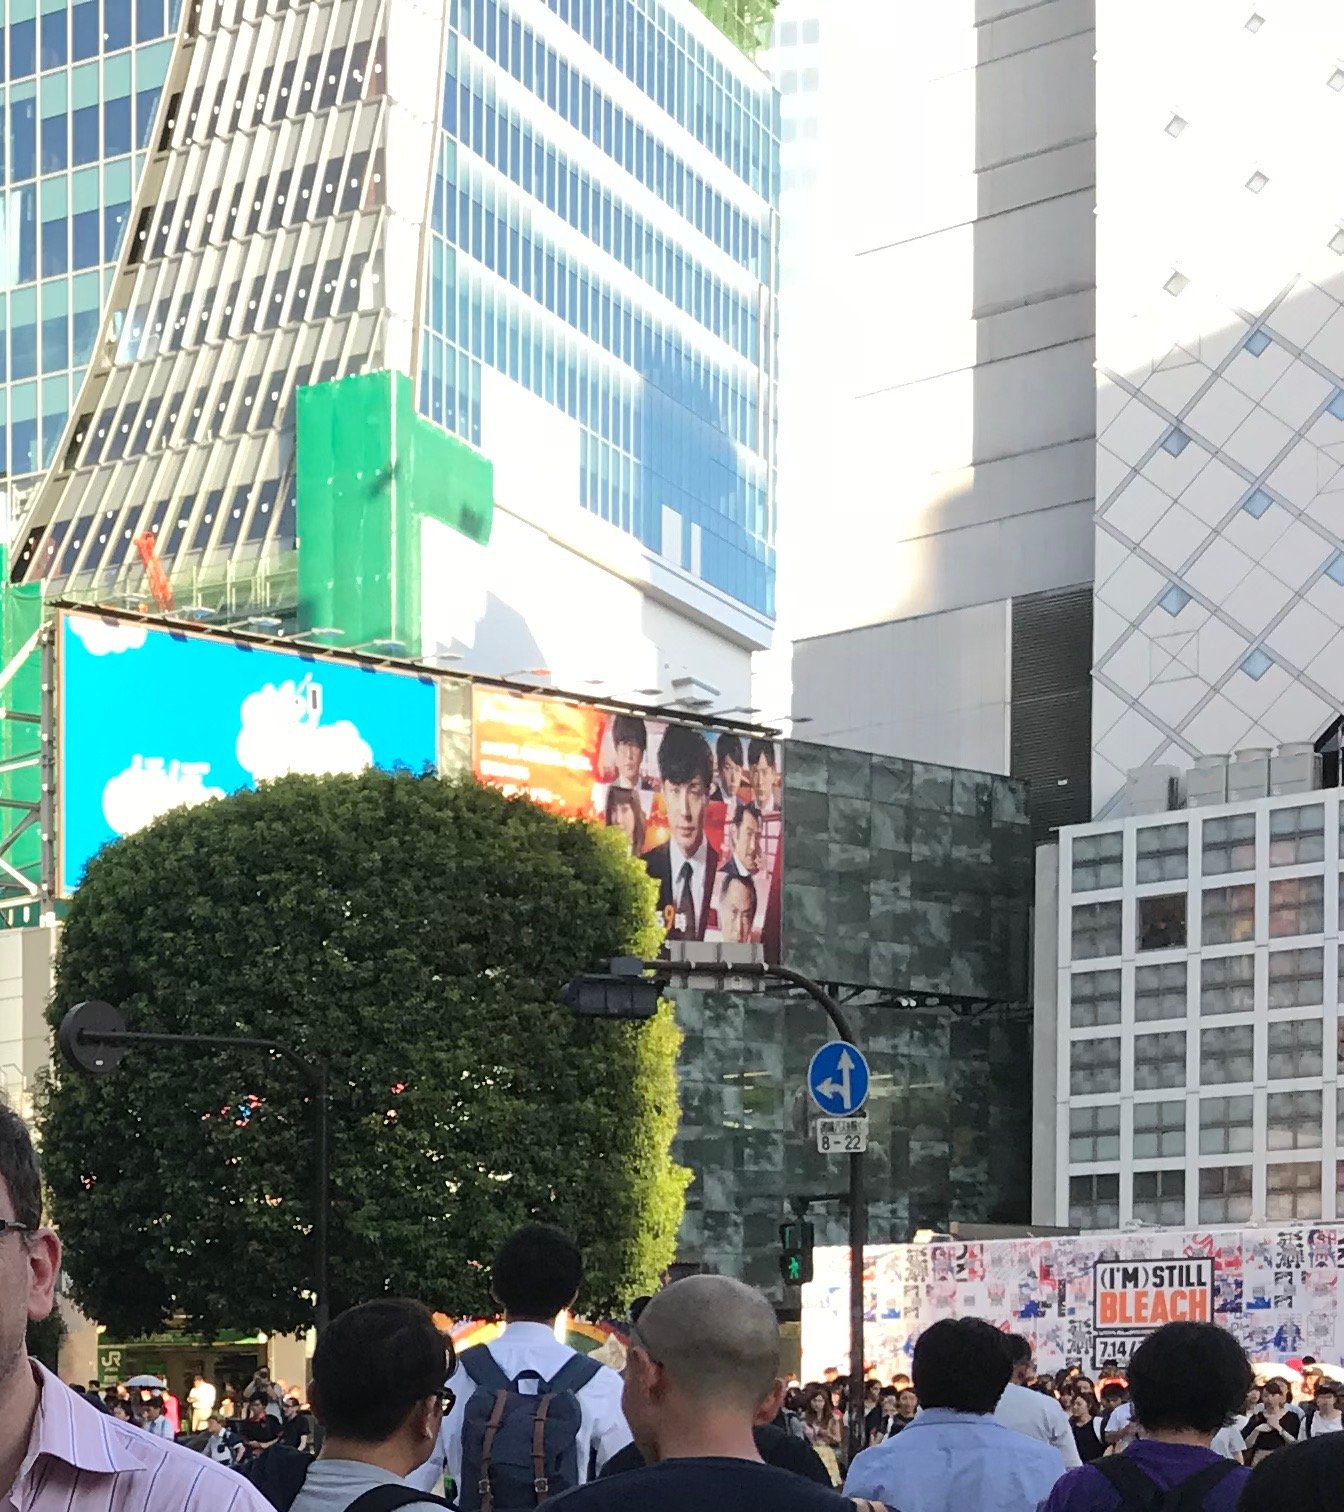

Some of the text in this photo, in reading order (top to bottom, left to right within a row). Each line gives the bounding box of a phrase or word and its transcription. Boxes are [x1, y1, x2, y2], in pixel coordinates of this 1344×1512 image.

[1151, 1263, 1208, 1289] STILL
[1099, 1288, 1208, 1325] BLEACH
[101, 1350, 121, 1367] JR
